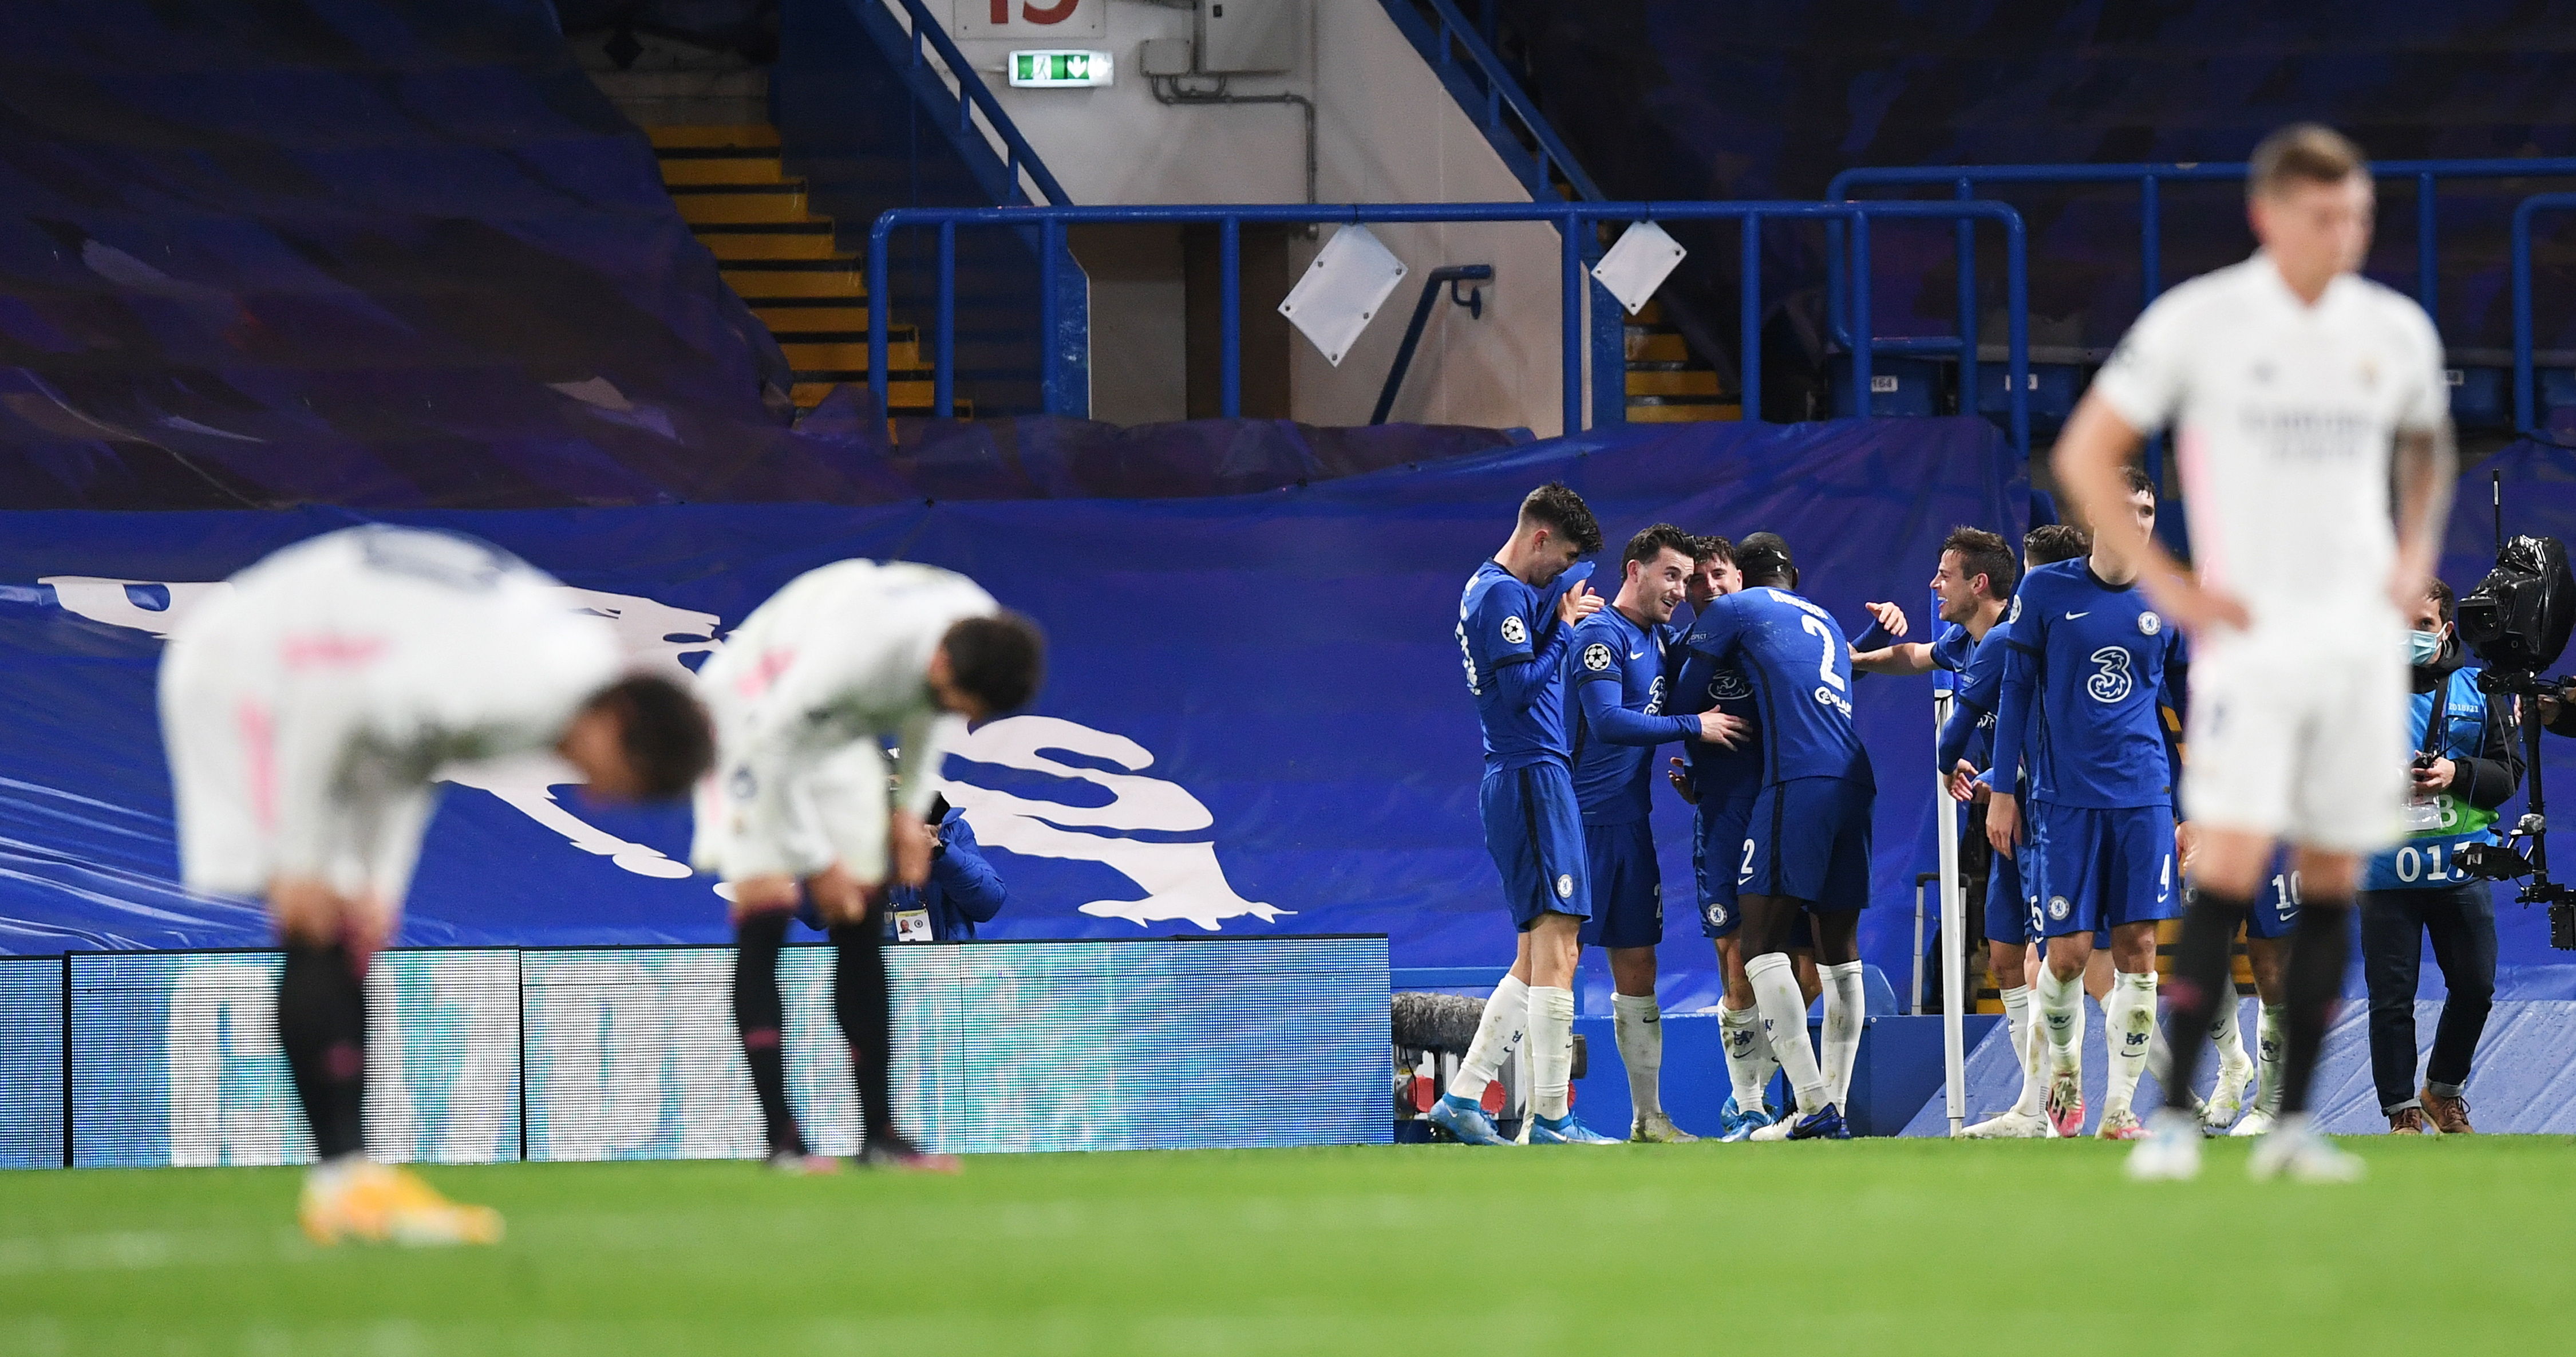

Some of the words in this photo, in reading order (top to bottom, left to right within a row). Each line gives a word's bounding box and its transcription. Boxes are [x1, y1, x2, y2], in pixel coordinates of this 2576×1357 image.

[1801, 614, 1845, 692] 2
[2087, 646, 2132, 703] 3
[1741, 839, 1755, 874] 2
[2160, 854, 2170, 891] 4
[2272, 870, 2302, 910] 10
[2030, 896, 2044, 931] 5
